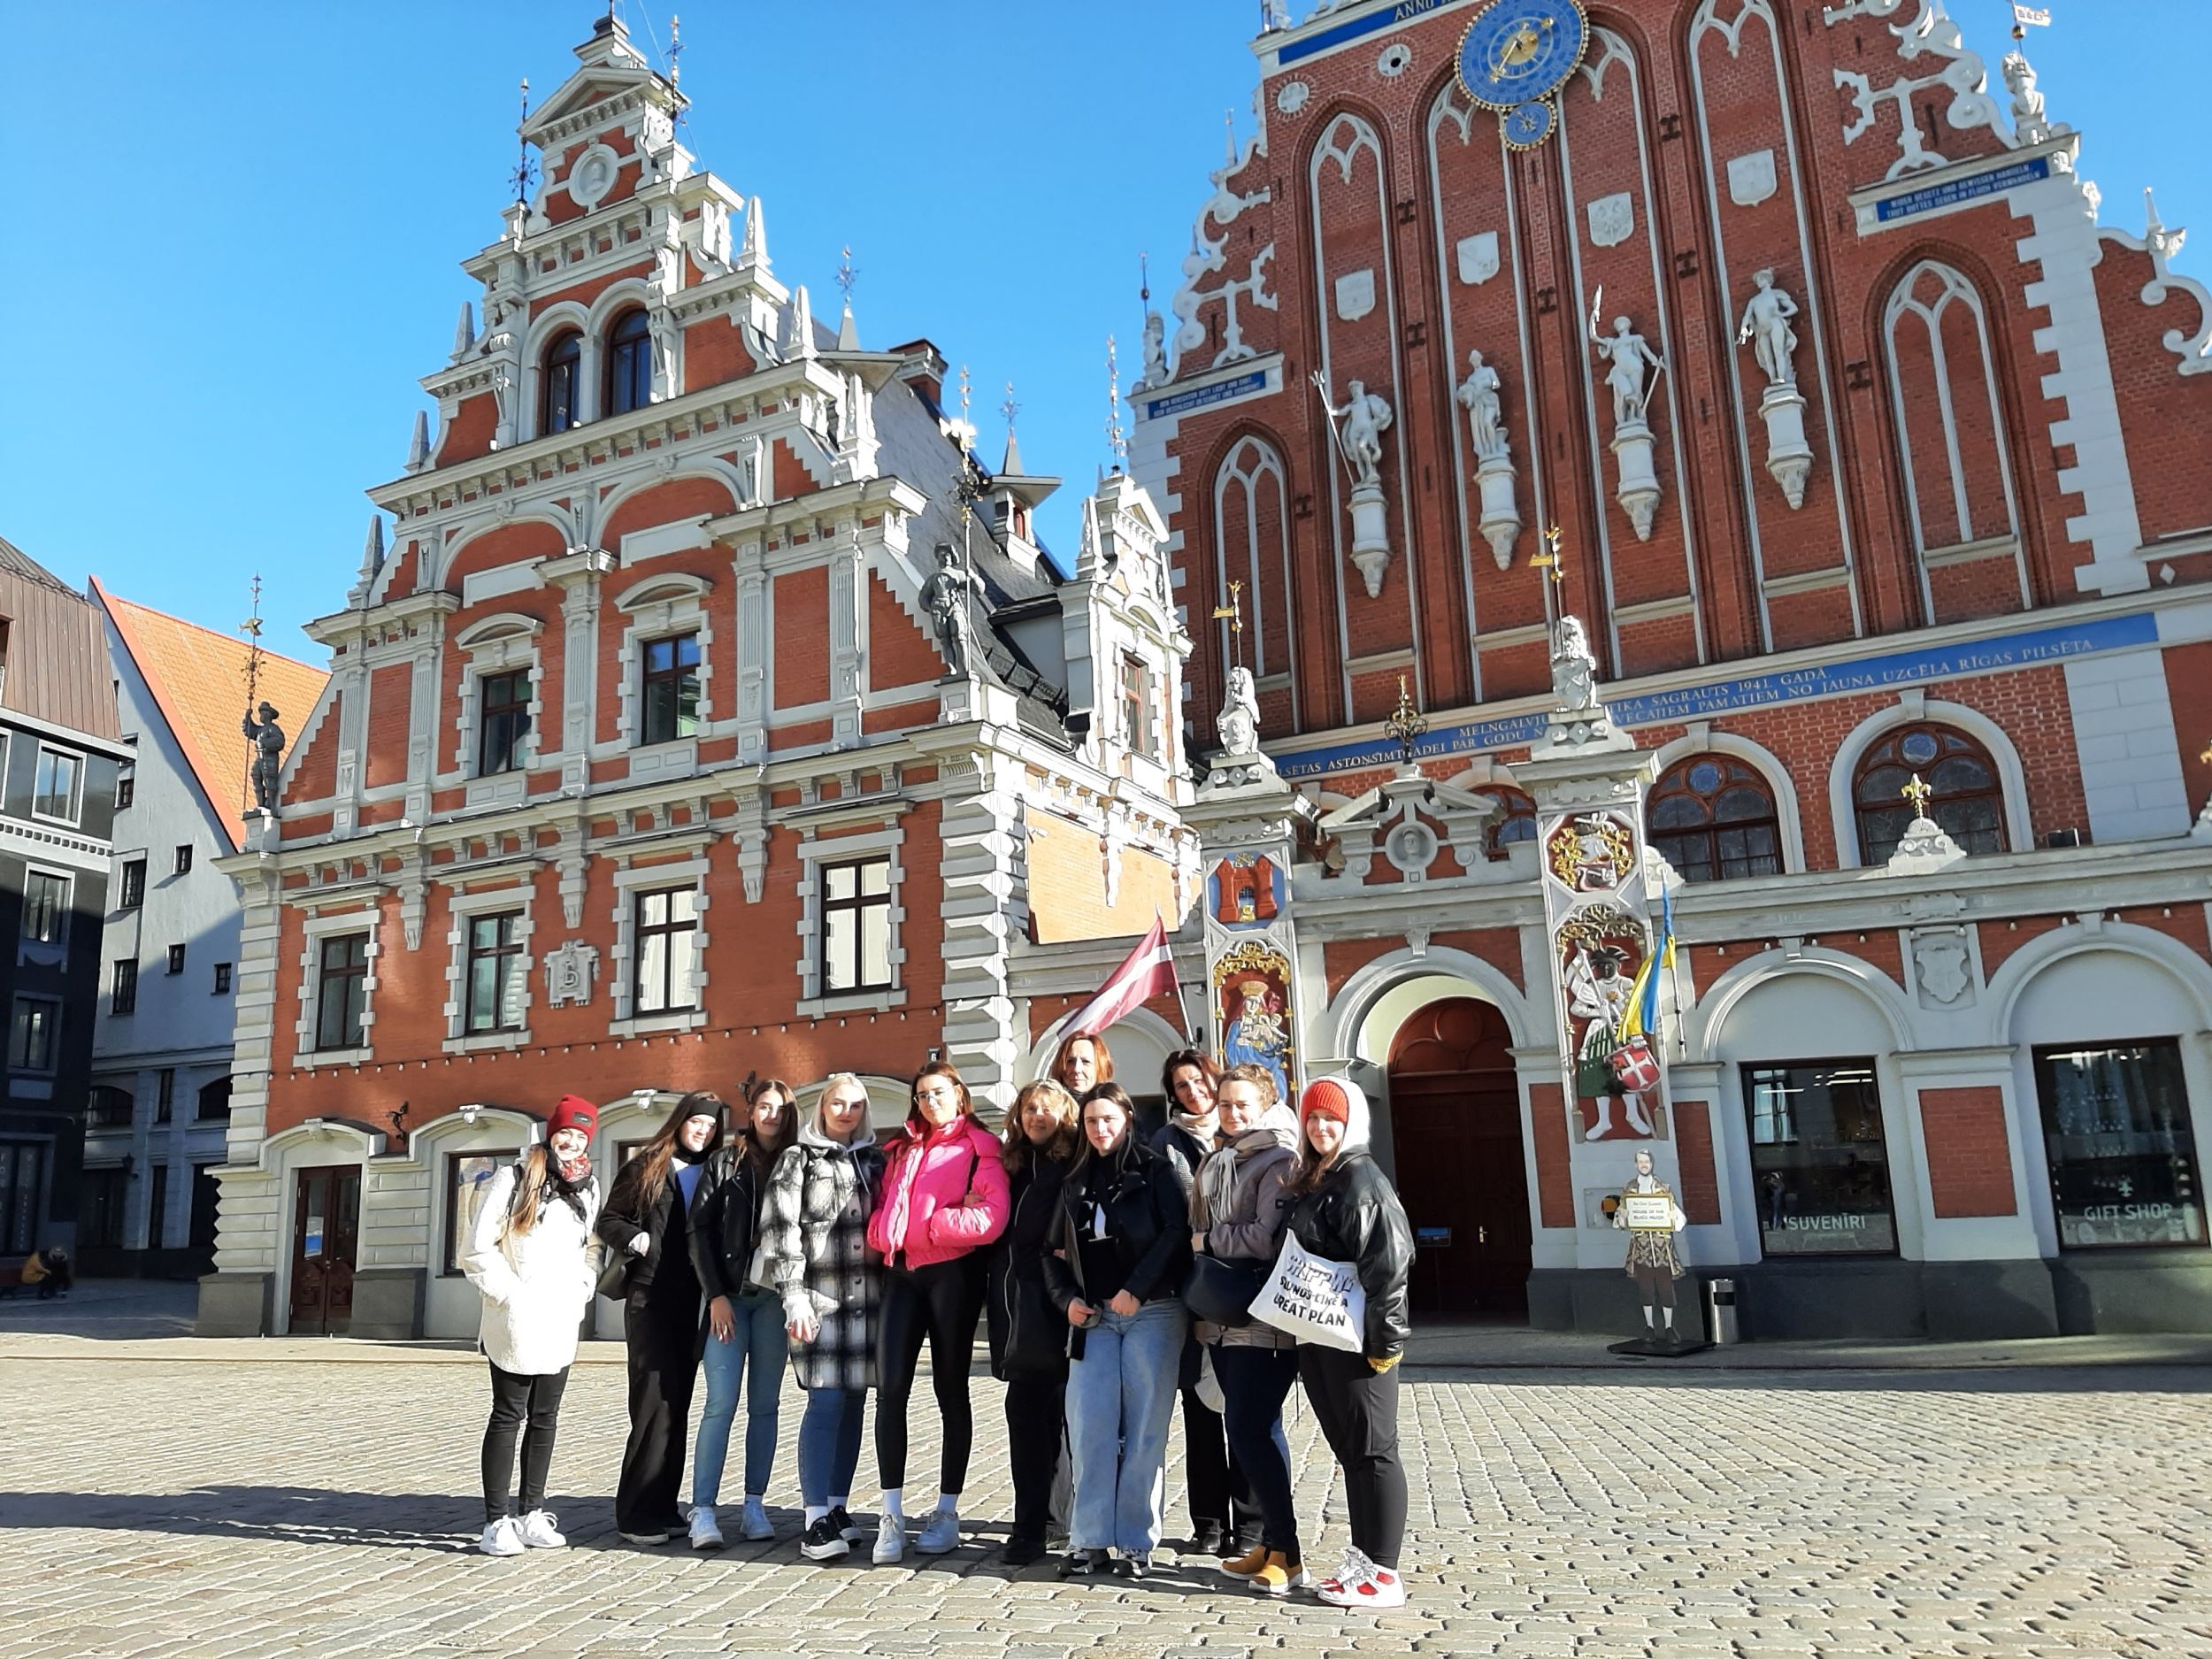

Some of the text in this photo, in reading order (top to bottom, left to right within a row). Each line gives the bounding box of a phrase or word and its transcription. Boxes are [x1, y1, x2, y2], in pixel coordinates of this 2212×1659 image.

[1484, 730, 1525, 746] GODU
[1615, 705, 1689, 724] VECAJIEM
[1699, 690, 1778, 711] PAMATIEM
[1787, 684, 1812, 698] NO
[1823, 674, 1874, 693] JAUNA
[1959, 651, 2012, 671] RĪGAS
[1651, 685, 1728, 707] SAGRAUTS
[931, 1053, 936, 1062] 6
[2084, 1203, 2173, 1221] GIFT SHOP
[1788, 1212, 1865, 1231] SUVENĪRI
[1340, 1298, 1348, 1308] A
[1309, 1310, 1346, 1326] PLAN
